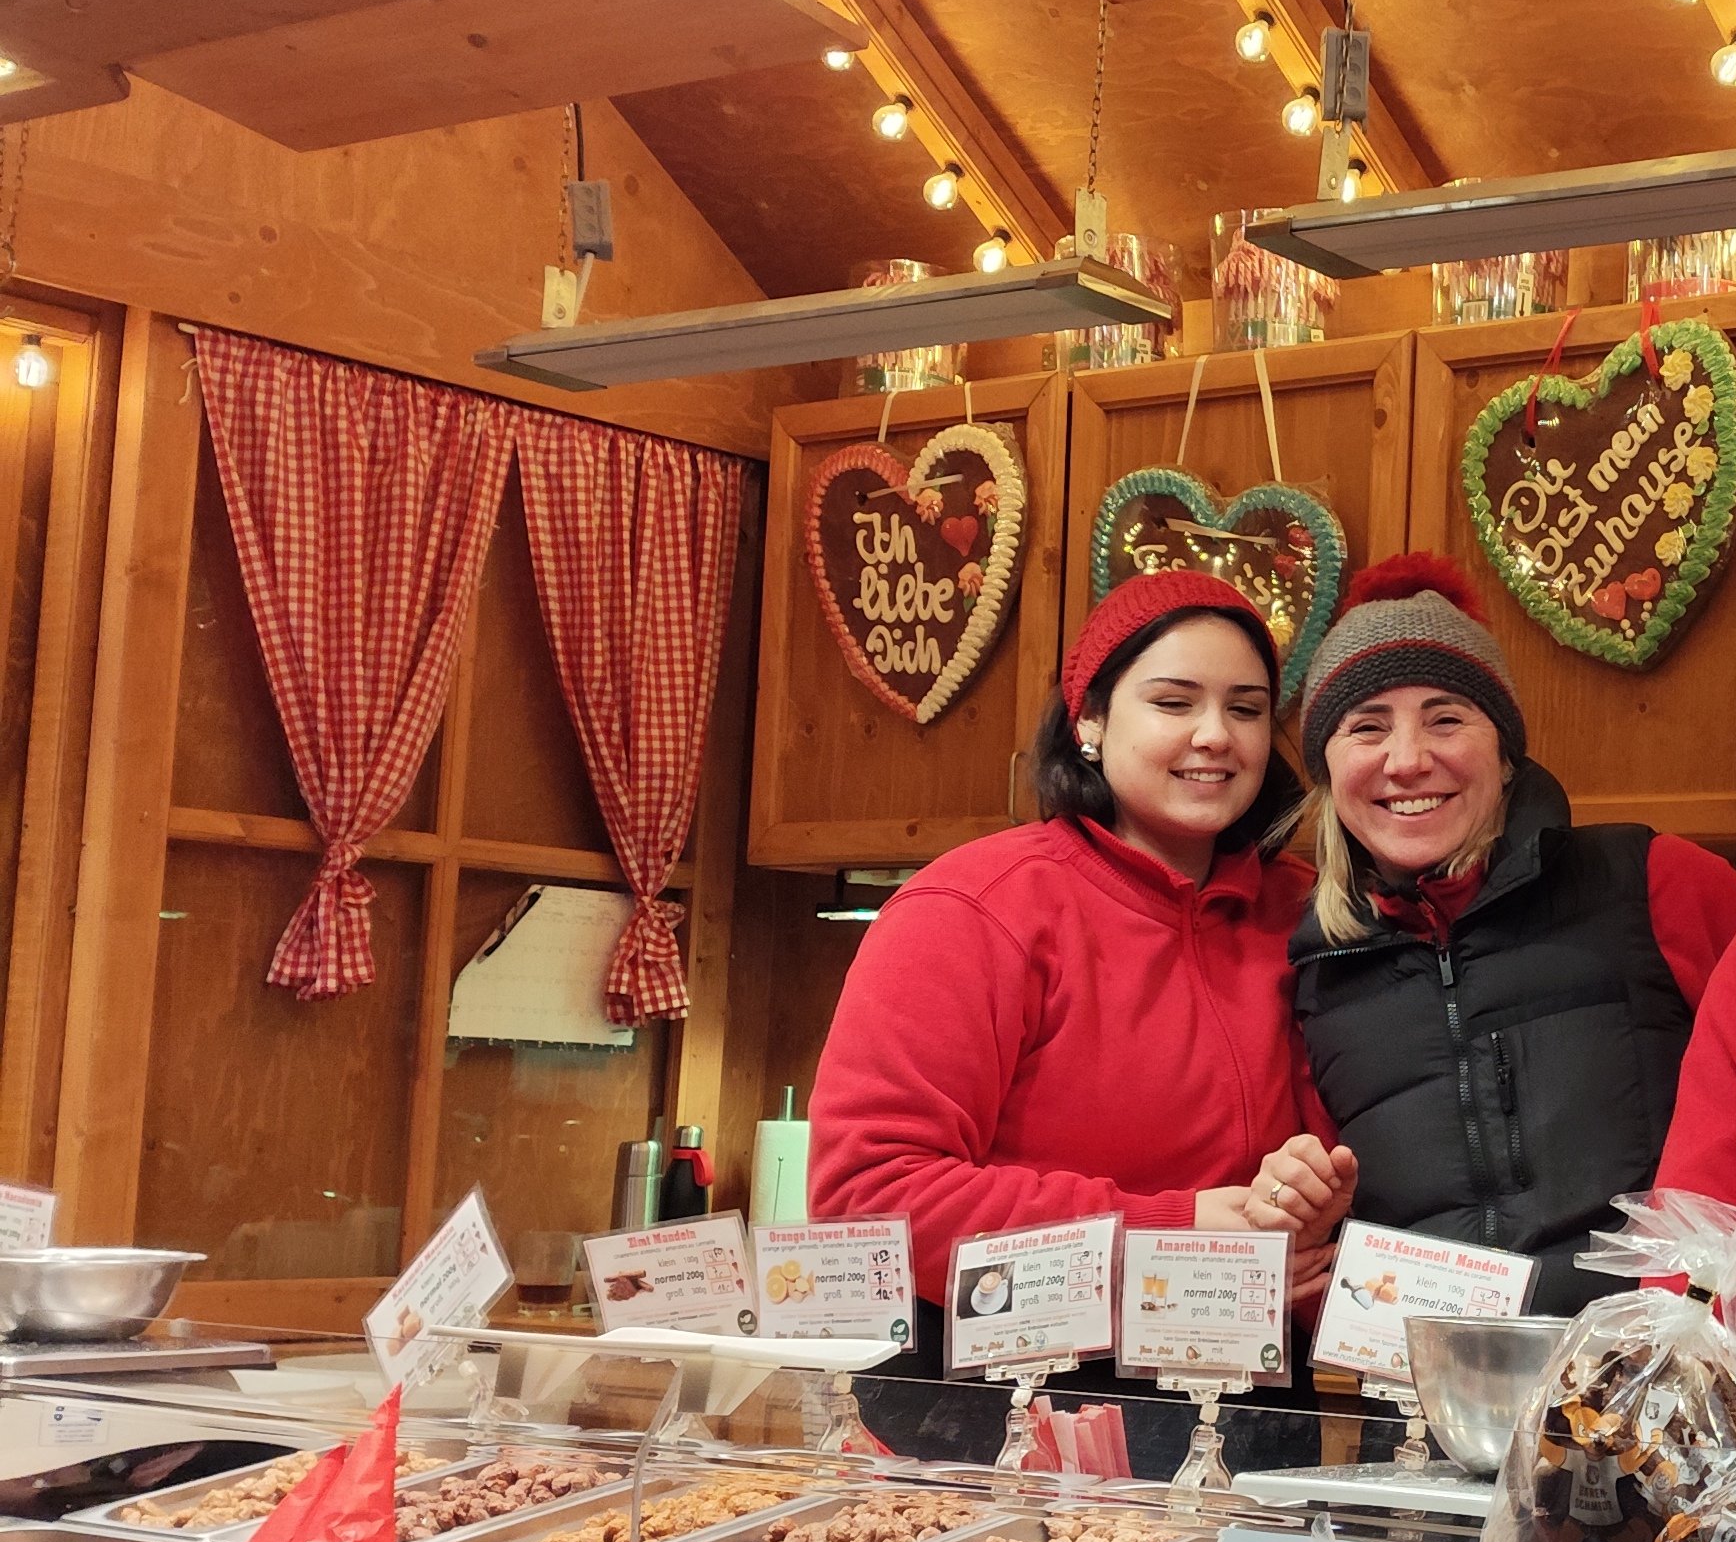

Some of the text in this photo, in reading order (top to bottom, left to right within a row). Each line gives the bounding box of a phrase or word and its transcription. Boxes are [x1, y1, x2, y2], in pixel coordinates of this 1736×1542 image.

[1501, 458, 1578, 534] Du
[1528, 403, 1666, 575] bist mein
[853, 512, 917, 564] Ich
[853, 563, 954, 624] liebe
[866, 629, 941, 675] Dich
[653, 1229, 696, 1245] Mandeln
[769, 1226, 891, 1244] Orange Ingwer Mandeln
[986, 1228, 1087, 1255] Café Latte Mandeln
[1156, 1239, 1255, 1254] Amaretto Mandeln
[1365, 1234, 1391, 1251] Salz
[1394, 1240, 1450, 1263] Karamell
[1456, 1254, 1509, 1276] Mandeln
[821, 1257, 839, 1266] klein
[1022, 1261, 1041, 1272] klein
[655, 1270, 705, 1285] normal 200g
[815, 1272, 865, 1284] normal 200g
[1013, 1274, 1065, 1292] normal 200g
[1193, 1270, 1237, 1282] klein 100g
[823, 1289, 842, 1301] groß
[1183, 1288, 1237, 1302] normal 200g
[1416, 1276, 1465, 1297] klein 100g
[1020, 1295, 1039, 1309] groß
[1402, 1293, 1463, 1315] normal 200g
[1191, 1306, 1235, 1319] groß 300g
